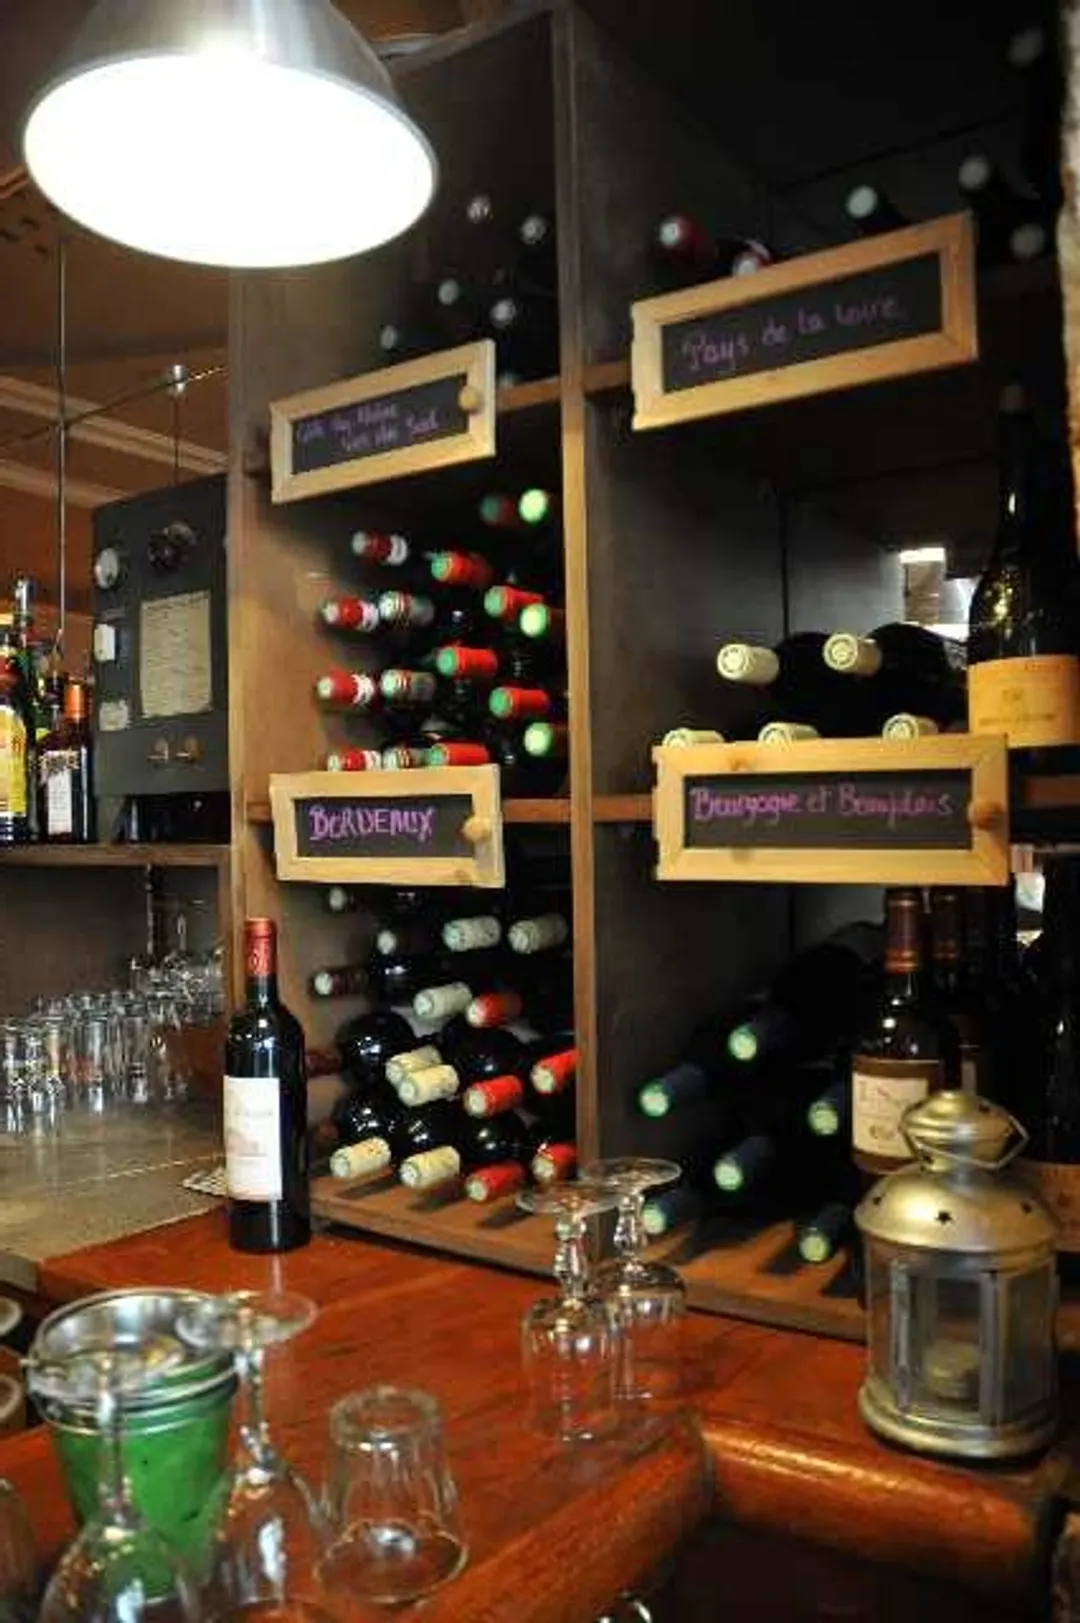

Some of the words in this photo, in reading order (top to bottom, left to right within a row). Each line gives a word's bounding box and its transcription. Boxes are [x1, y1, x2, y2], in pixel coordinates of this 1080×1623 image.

[682, 330, 749, 373] Pays
[760, 314, 788, 346] de
[797, 308, 826, 334] la
